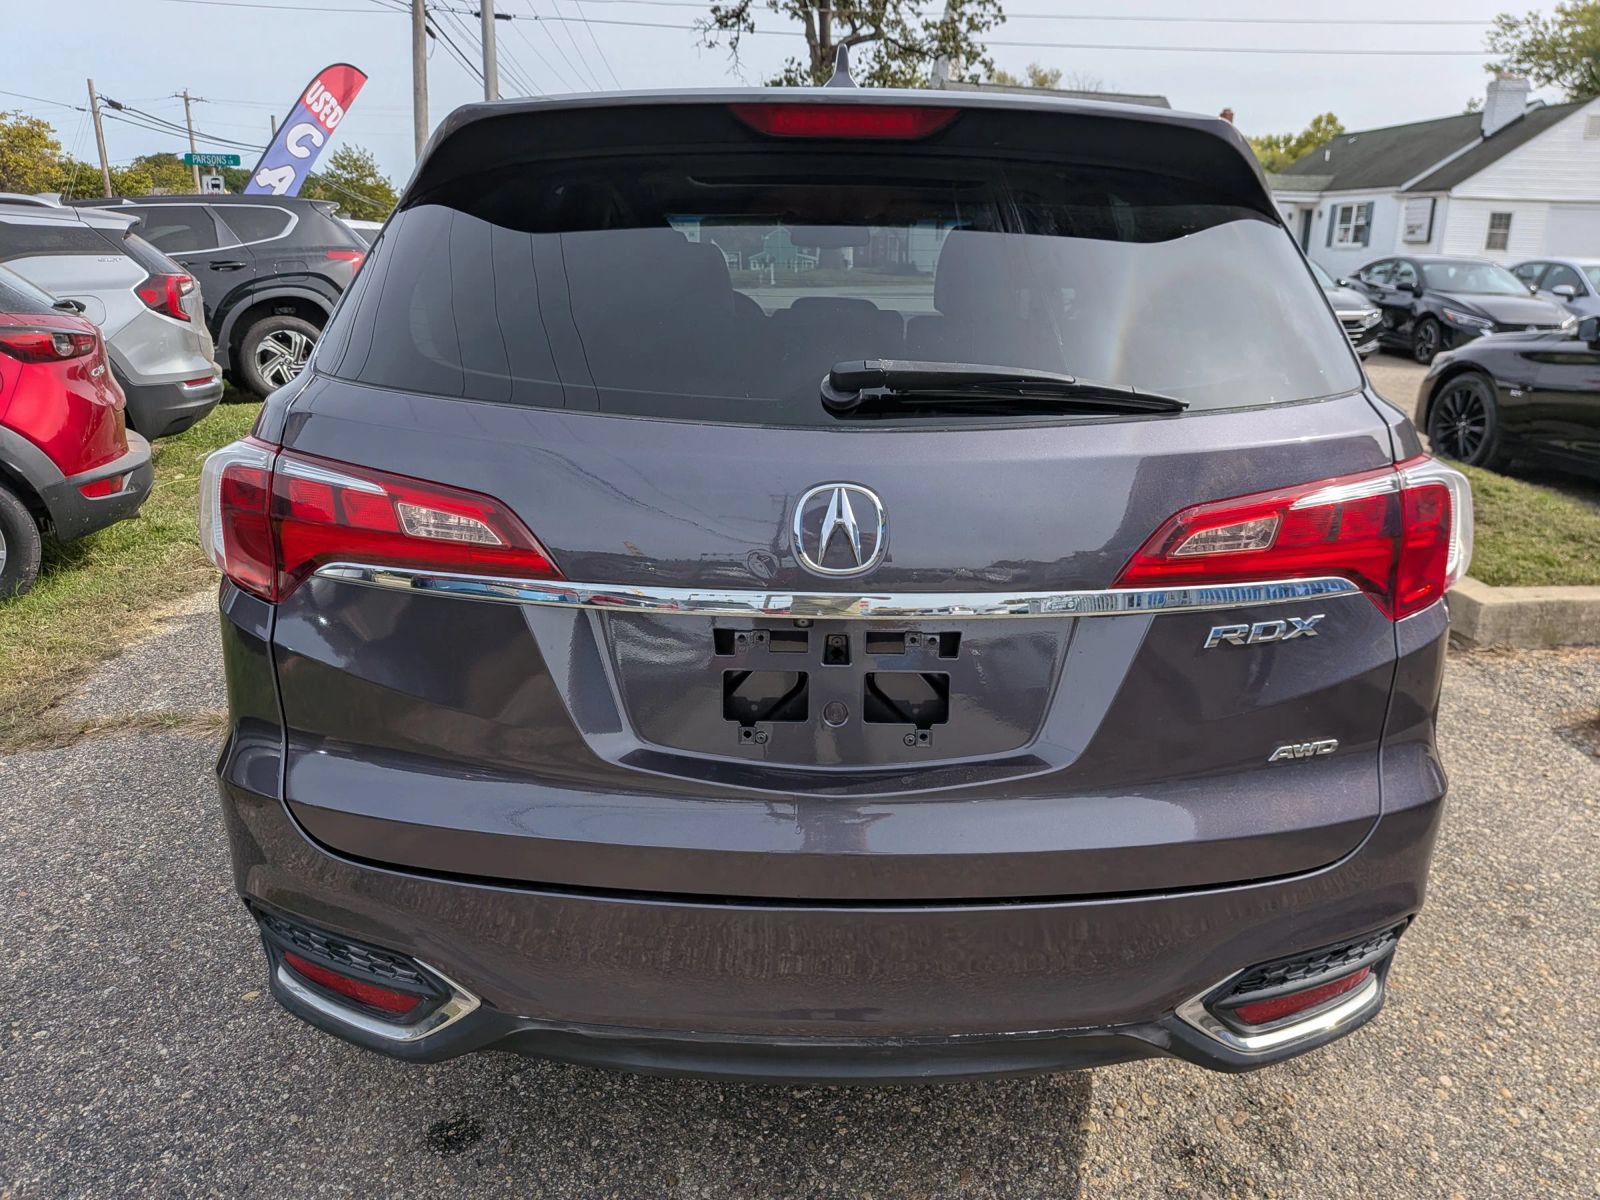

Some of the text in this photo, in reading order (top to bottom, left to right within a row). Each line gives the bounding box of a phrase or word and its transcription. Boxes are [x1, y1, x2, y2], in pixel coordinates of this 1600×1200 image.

[305, 79, 344, 129] USED
[192, 154, 226, 165] PARSONS
[255, 122, 324, 195] CA
[1203, 613, 1326, 649] RDX
[1267, 738, 1339, 762] AWD
